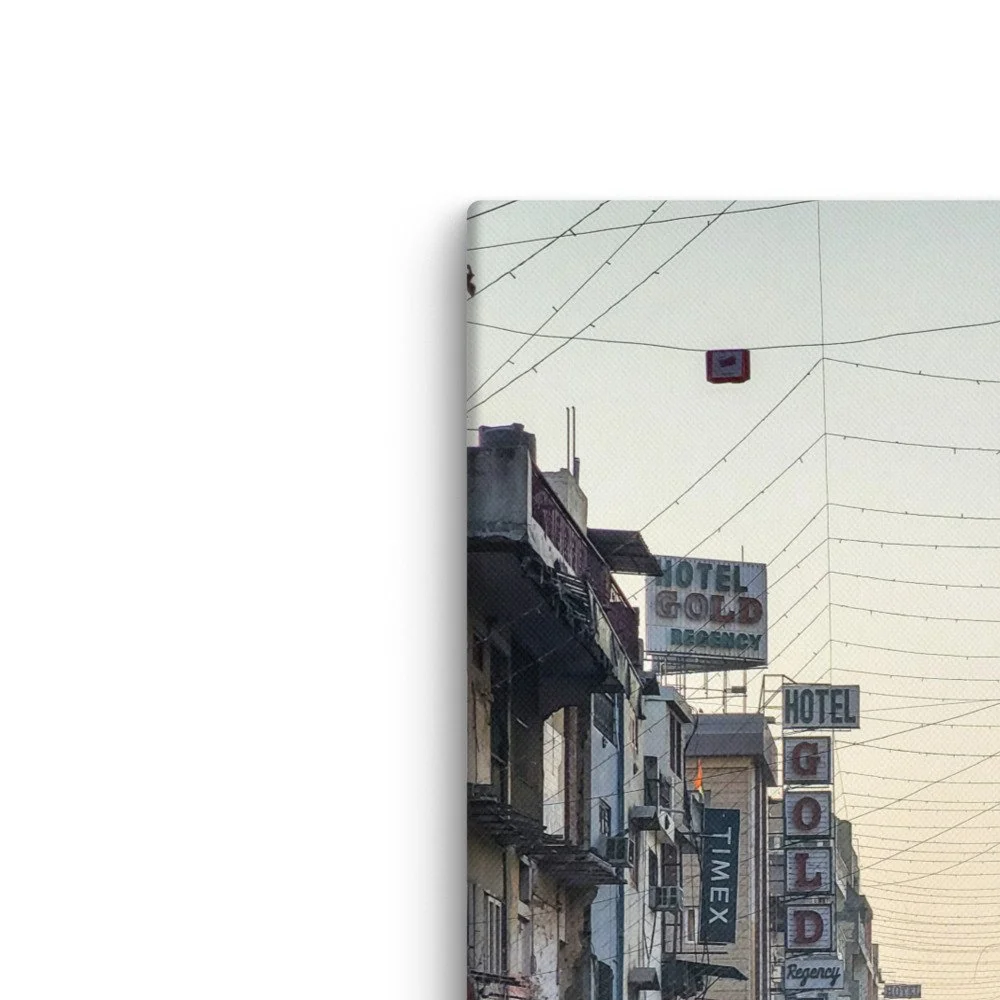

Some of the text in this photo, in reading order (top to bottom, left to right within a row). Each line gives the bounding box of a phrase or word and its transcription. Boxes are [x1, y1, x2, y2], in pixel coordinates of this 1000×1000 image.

[655, 559, 748, 592] HOTEL
[655, 590, 763, 624] GOLD
[670, 628, 762, 651] REGENCY
[785, 689, 856, 724] HOTEL
[792, 741, 824, 945] GOLD
[708, 826, 732, 924] TIMEX
[786, 963, 841, 987] Regency
